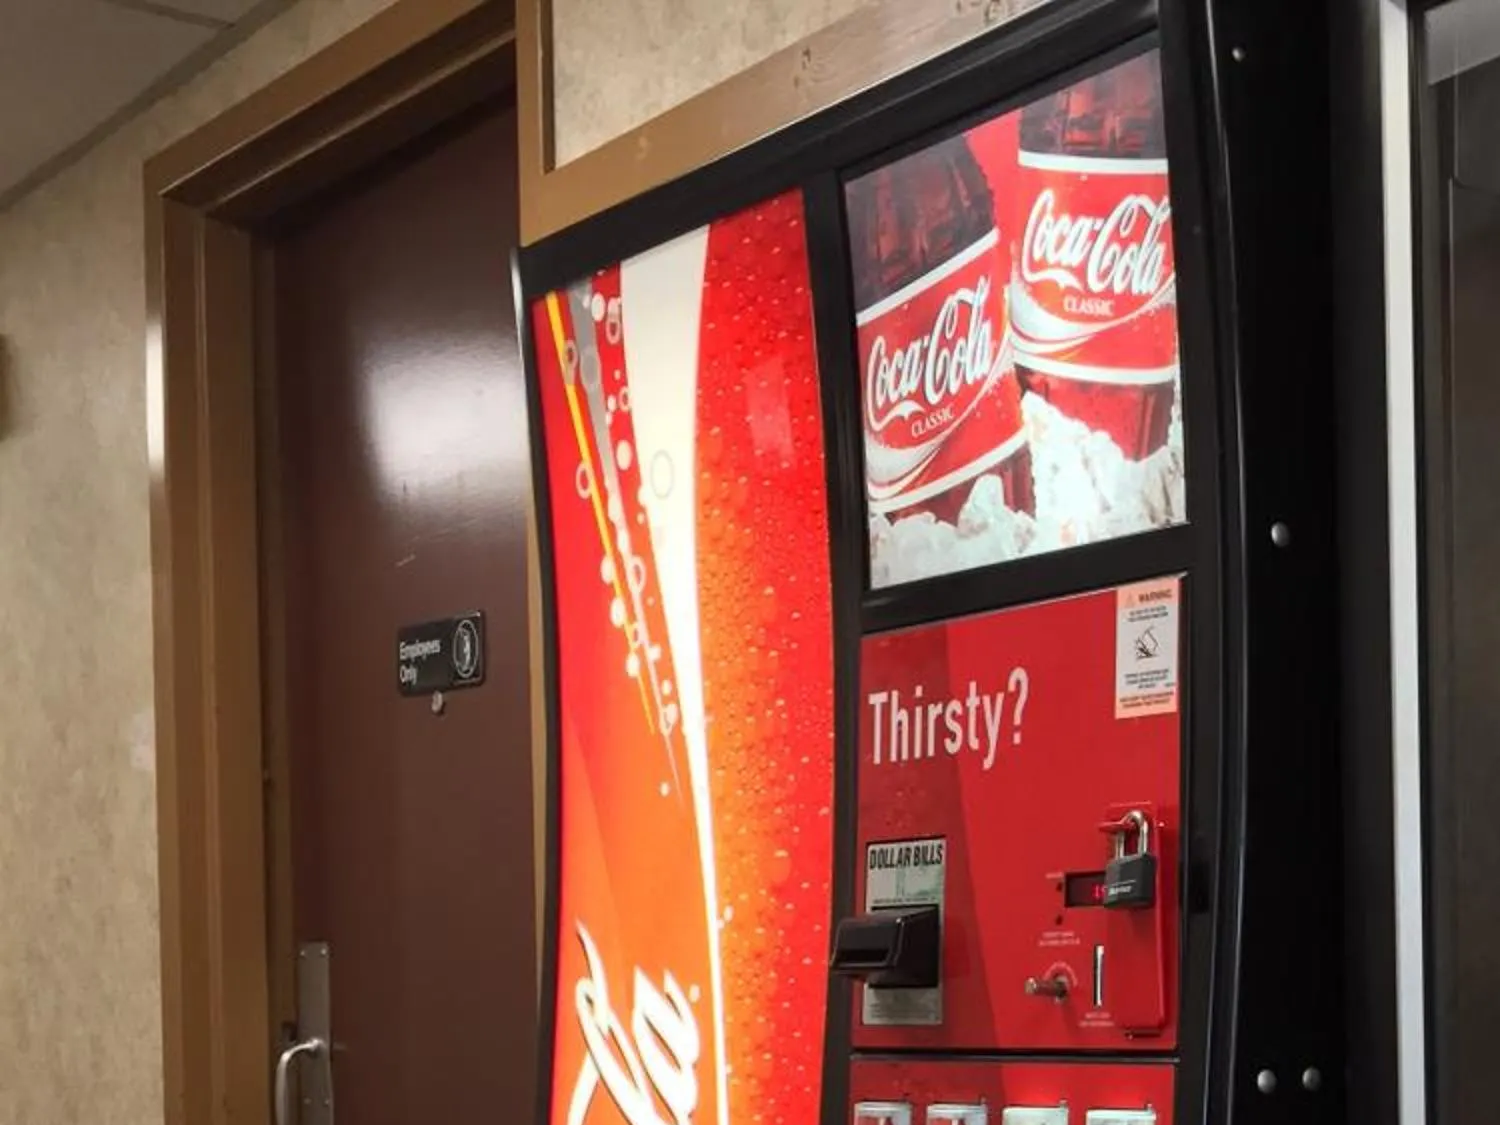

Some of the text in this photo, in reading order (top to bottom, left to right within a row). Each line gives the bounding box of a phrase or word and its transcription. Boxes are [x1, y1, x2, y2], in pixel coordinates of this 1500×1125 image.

[1062, 295, 1115, 317] CLASSIC
[867, 275, 994, 432] Coca-Cola
[910, 404, 954, 438] CLASSIC
[868, 666, 1030, 770] Thirsty?
[869, 844, 943, 870] DOLLAR BILLS
